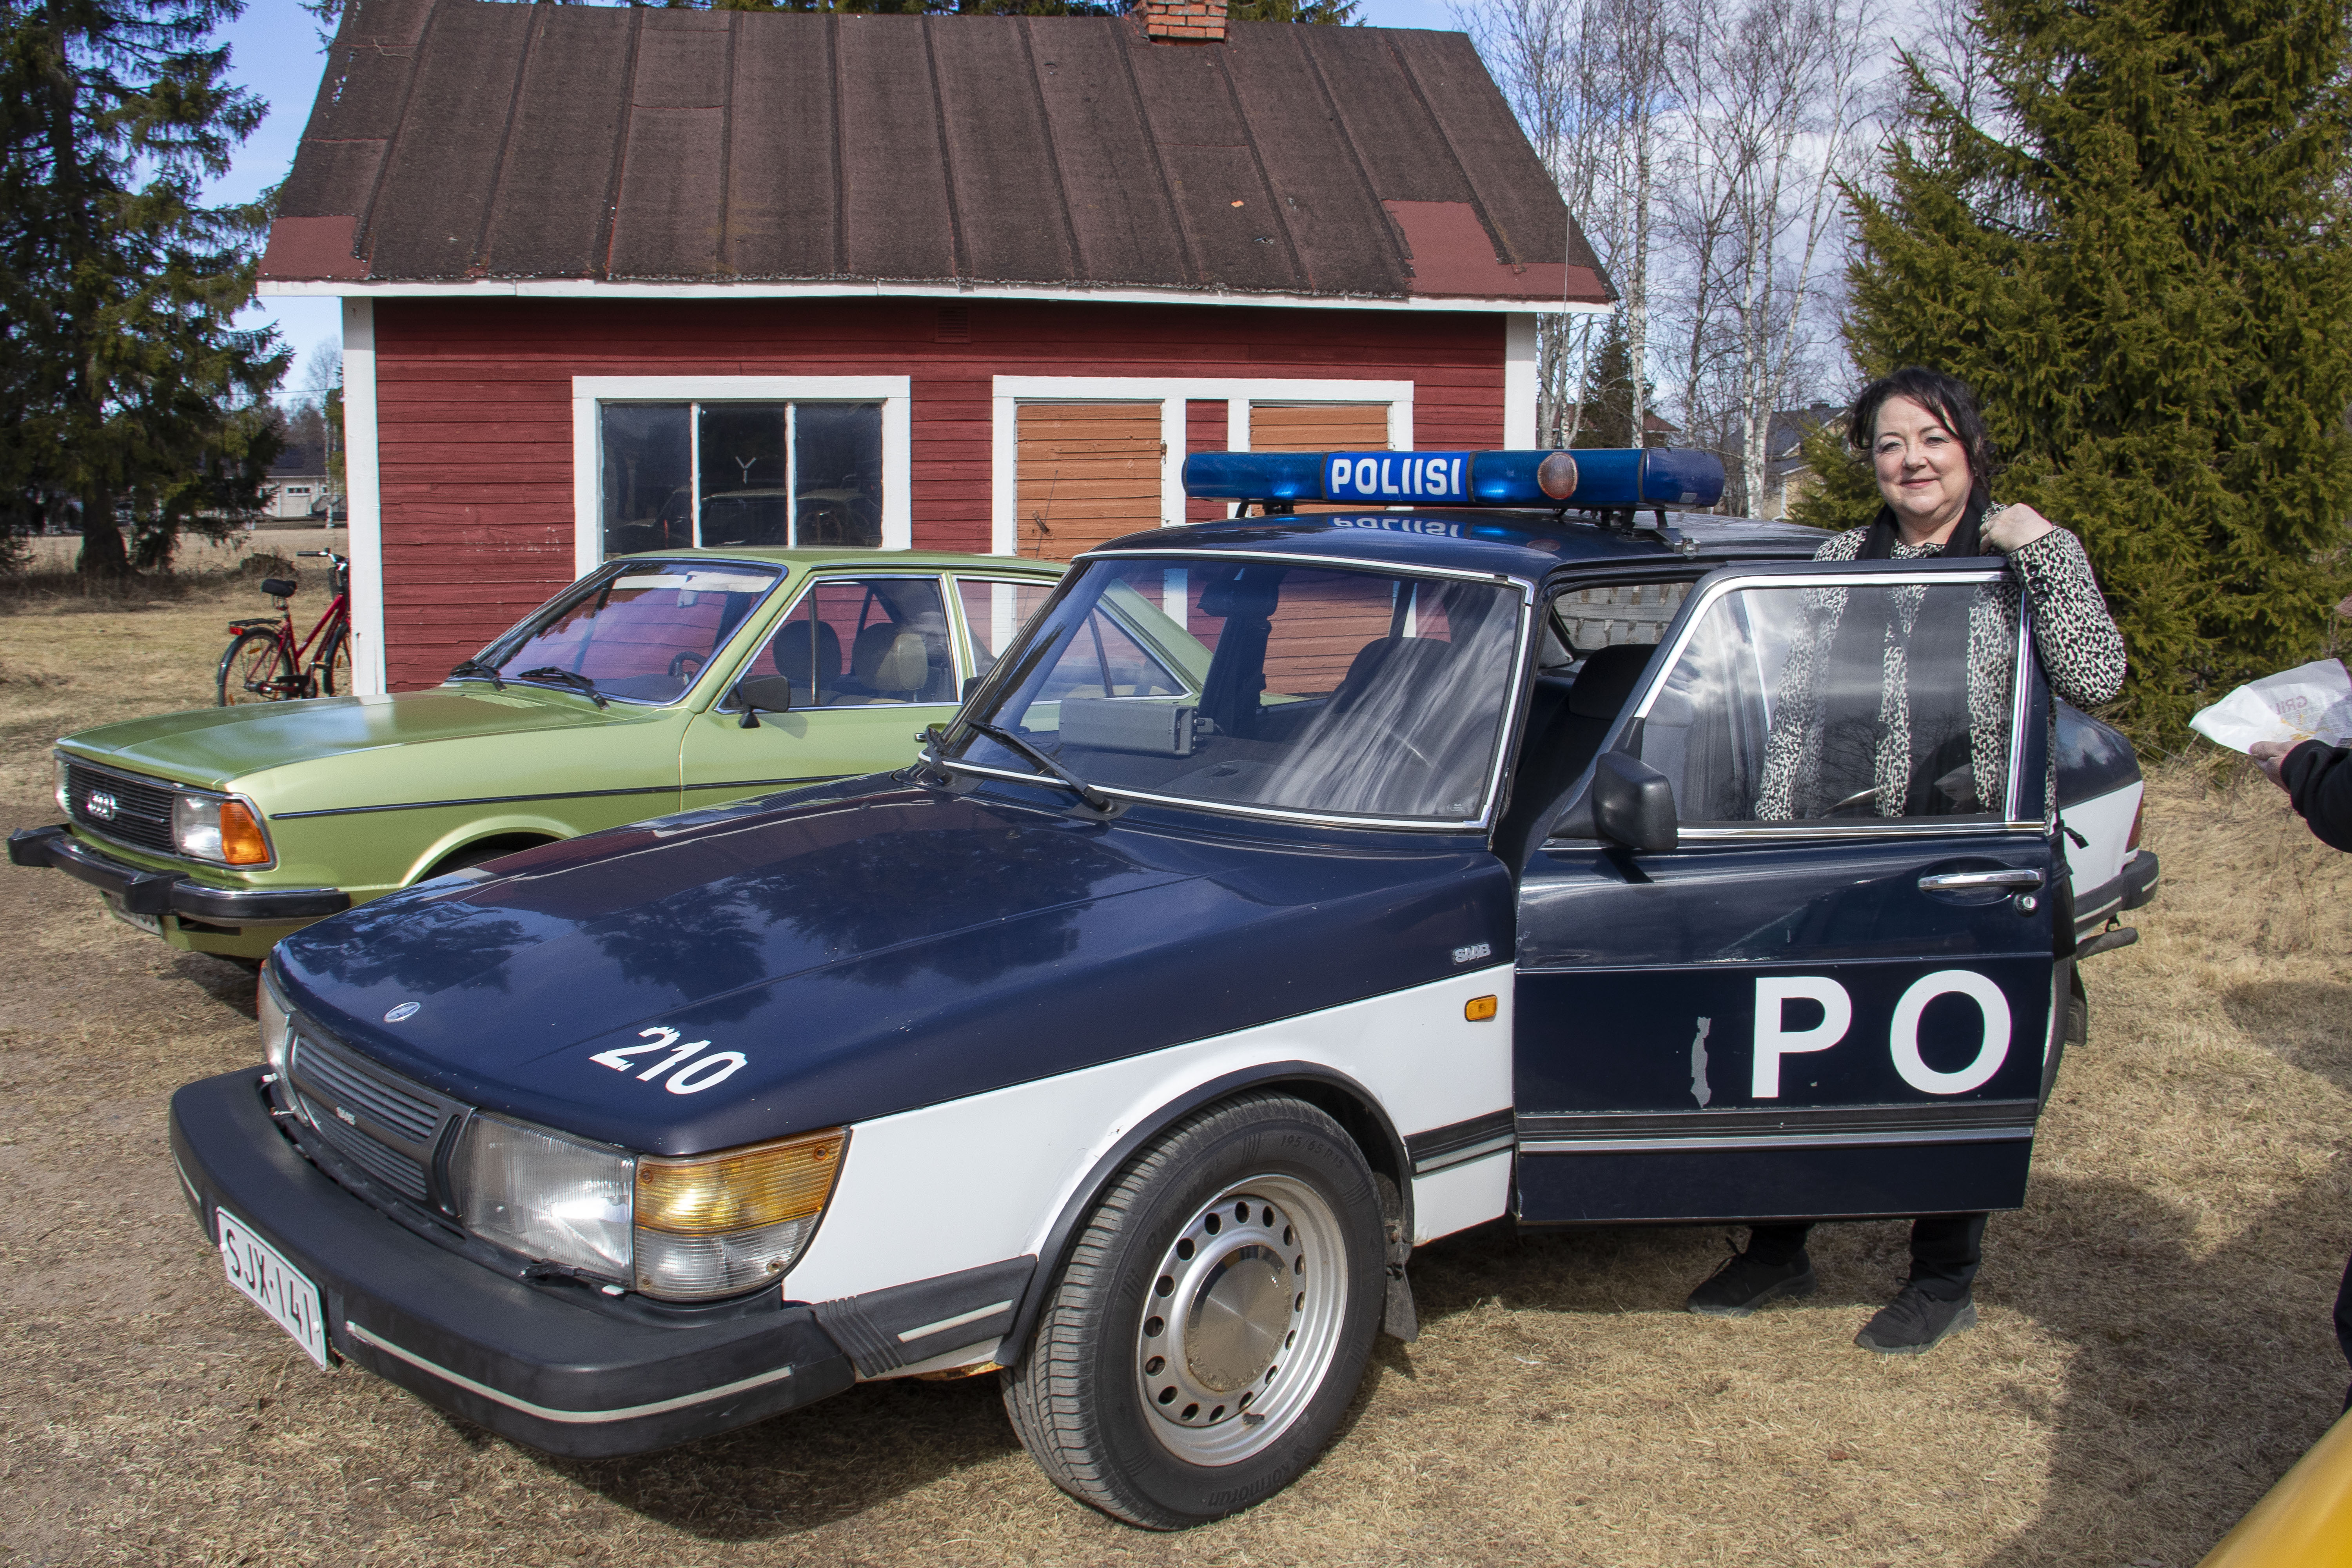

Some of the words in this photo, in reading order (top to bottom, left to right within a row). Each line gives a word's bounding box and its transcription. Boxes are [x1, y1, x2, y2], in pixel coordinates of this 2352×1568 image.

[1331, 458, 1461, 495] POLIISI
[1454, 943, 1491, 963] SAAB
[589, 1026, 748, 1094] 210
[1752, 970, 2012, 1098] PO
[1281, 1135, 1324, 1154] 195/65
[1323, 1148, 1345, 1169] R15
[226, 1228, 313, 1346] SJX-141
